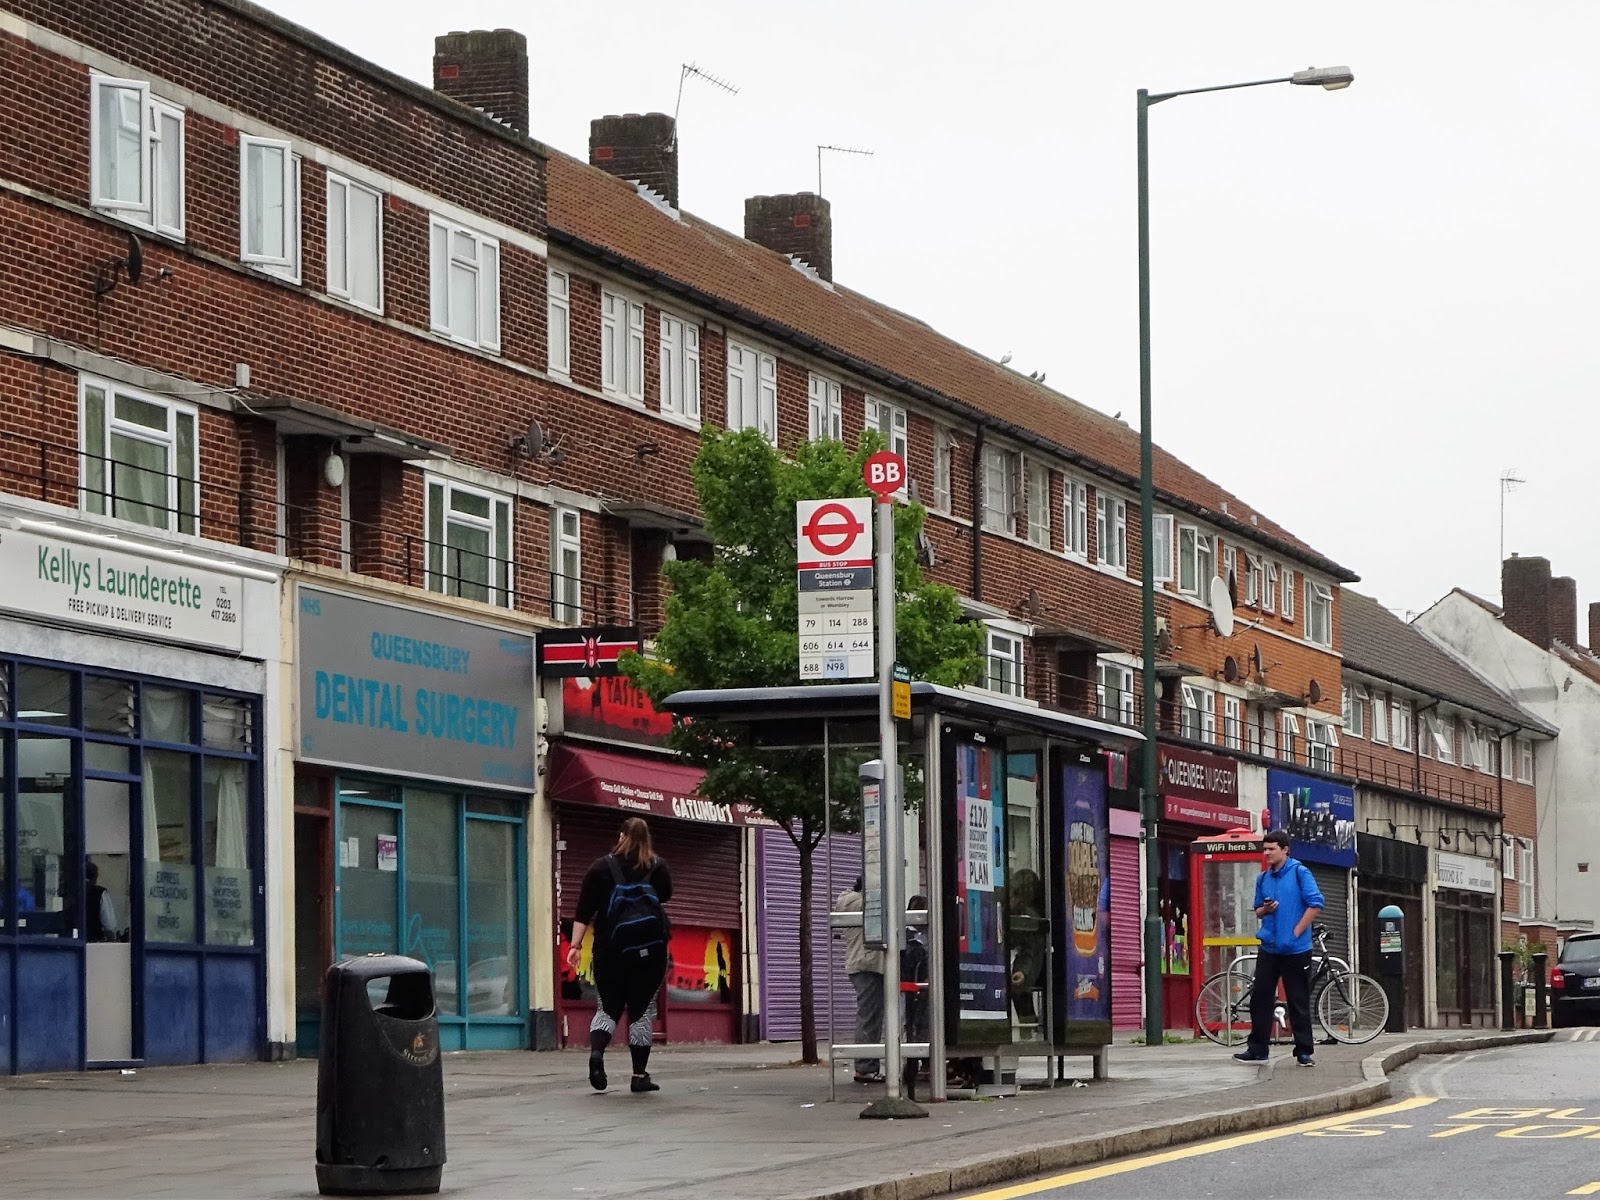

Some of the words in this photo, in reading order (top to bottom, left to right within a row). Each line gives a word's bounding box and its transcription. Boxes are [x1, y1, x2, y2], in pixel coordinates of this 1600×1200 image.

[871, 462, 900, 484] BB
[38, 545, 91, 595] Kellys
[97, 557, 202, 609] Launderette
[814, 571, 855, 580] Queensbury
[216, 597, 231, 610] 0203
[68, 598, 84, 613] FREE
[85, 601, 109, 617] PICKUP
[110, 606, 115, 619] &
[116, 607, 146, 624] DELIVERY
[147, 613, 172, 629] SERVICE
[211, 609, 220, 620] 417
[805, 619, 816, 628] 79
[829, 619, 841, 627] 114
[852, 618, 868, 626] 288
[803, 641, 819, 650] 606
[827, 641, 843, 649] 614
[852, 640, 869, 648] 644
[370, 631, 470, 674] QUEENSBURY
[803, 663, 819, 672] 688
[826, 662, 845, 671] N98
[315, 670, 408, 733] DENTAL
[415, 688, 518, 749] SURGERY
[1168, 758, 1205, 789] QUEENBEE
[1205, 766, 1237, 795] NURSERY
[969, 804, 988, 829] £120
[1207, 843, 1225, 852] WiFi
[1228, 843, 1246, 851] here
[969, 861, 989, 886] PLAN
[1302, 1123, 1600, 1139] STO
